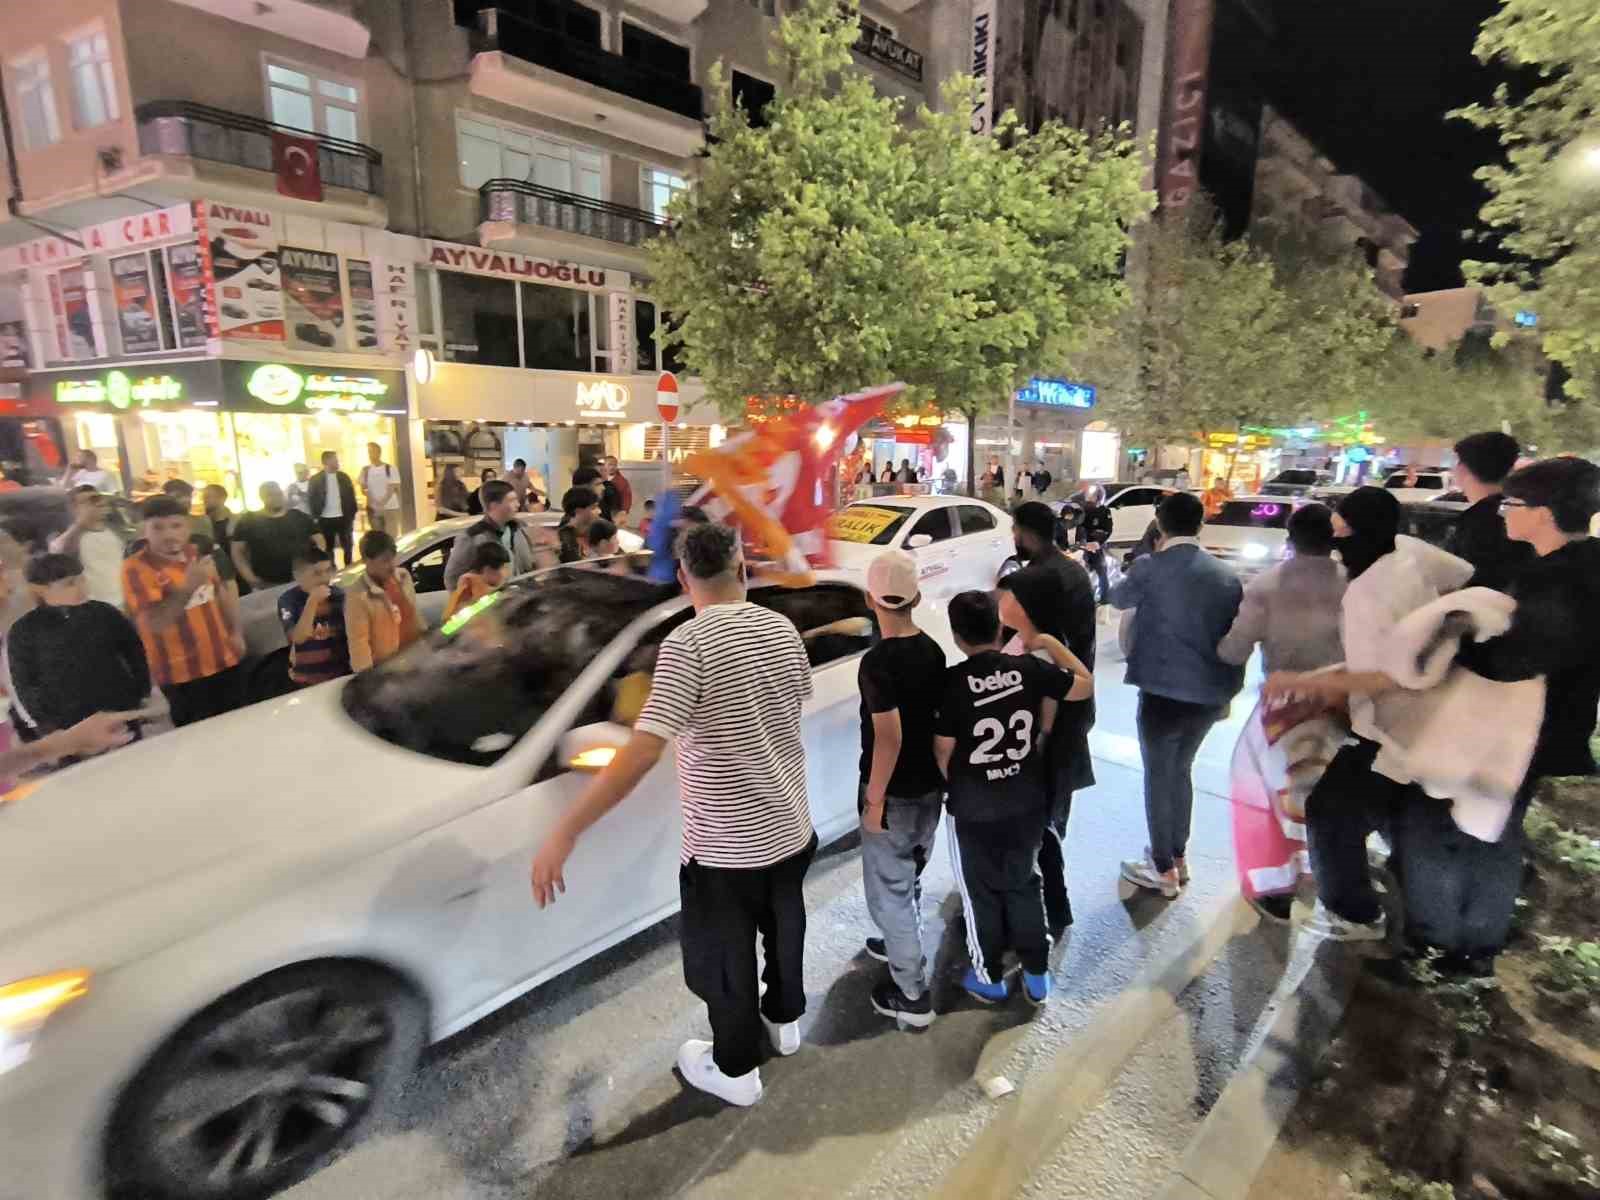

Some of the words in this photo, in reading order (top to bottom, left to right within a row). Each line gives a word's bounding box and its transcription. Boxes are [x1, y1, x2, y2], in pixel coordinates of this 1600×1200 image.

[123, 212, 171, 243] CAR
[967, 670, 1023, 693] beko
[969, 709, 1034, 765] 23
